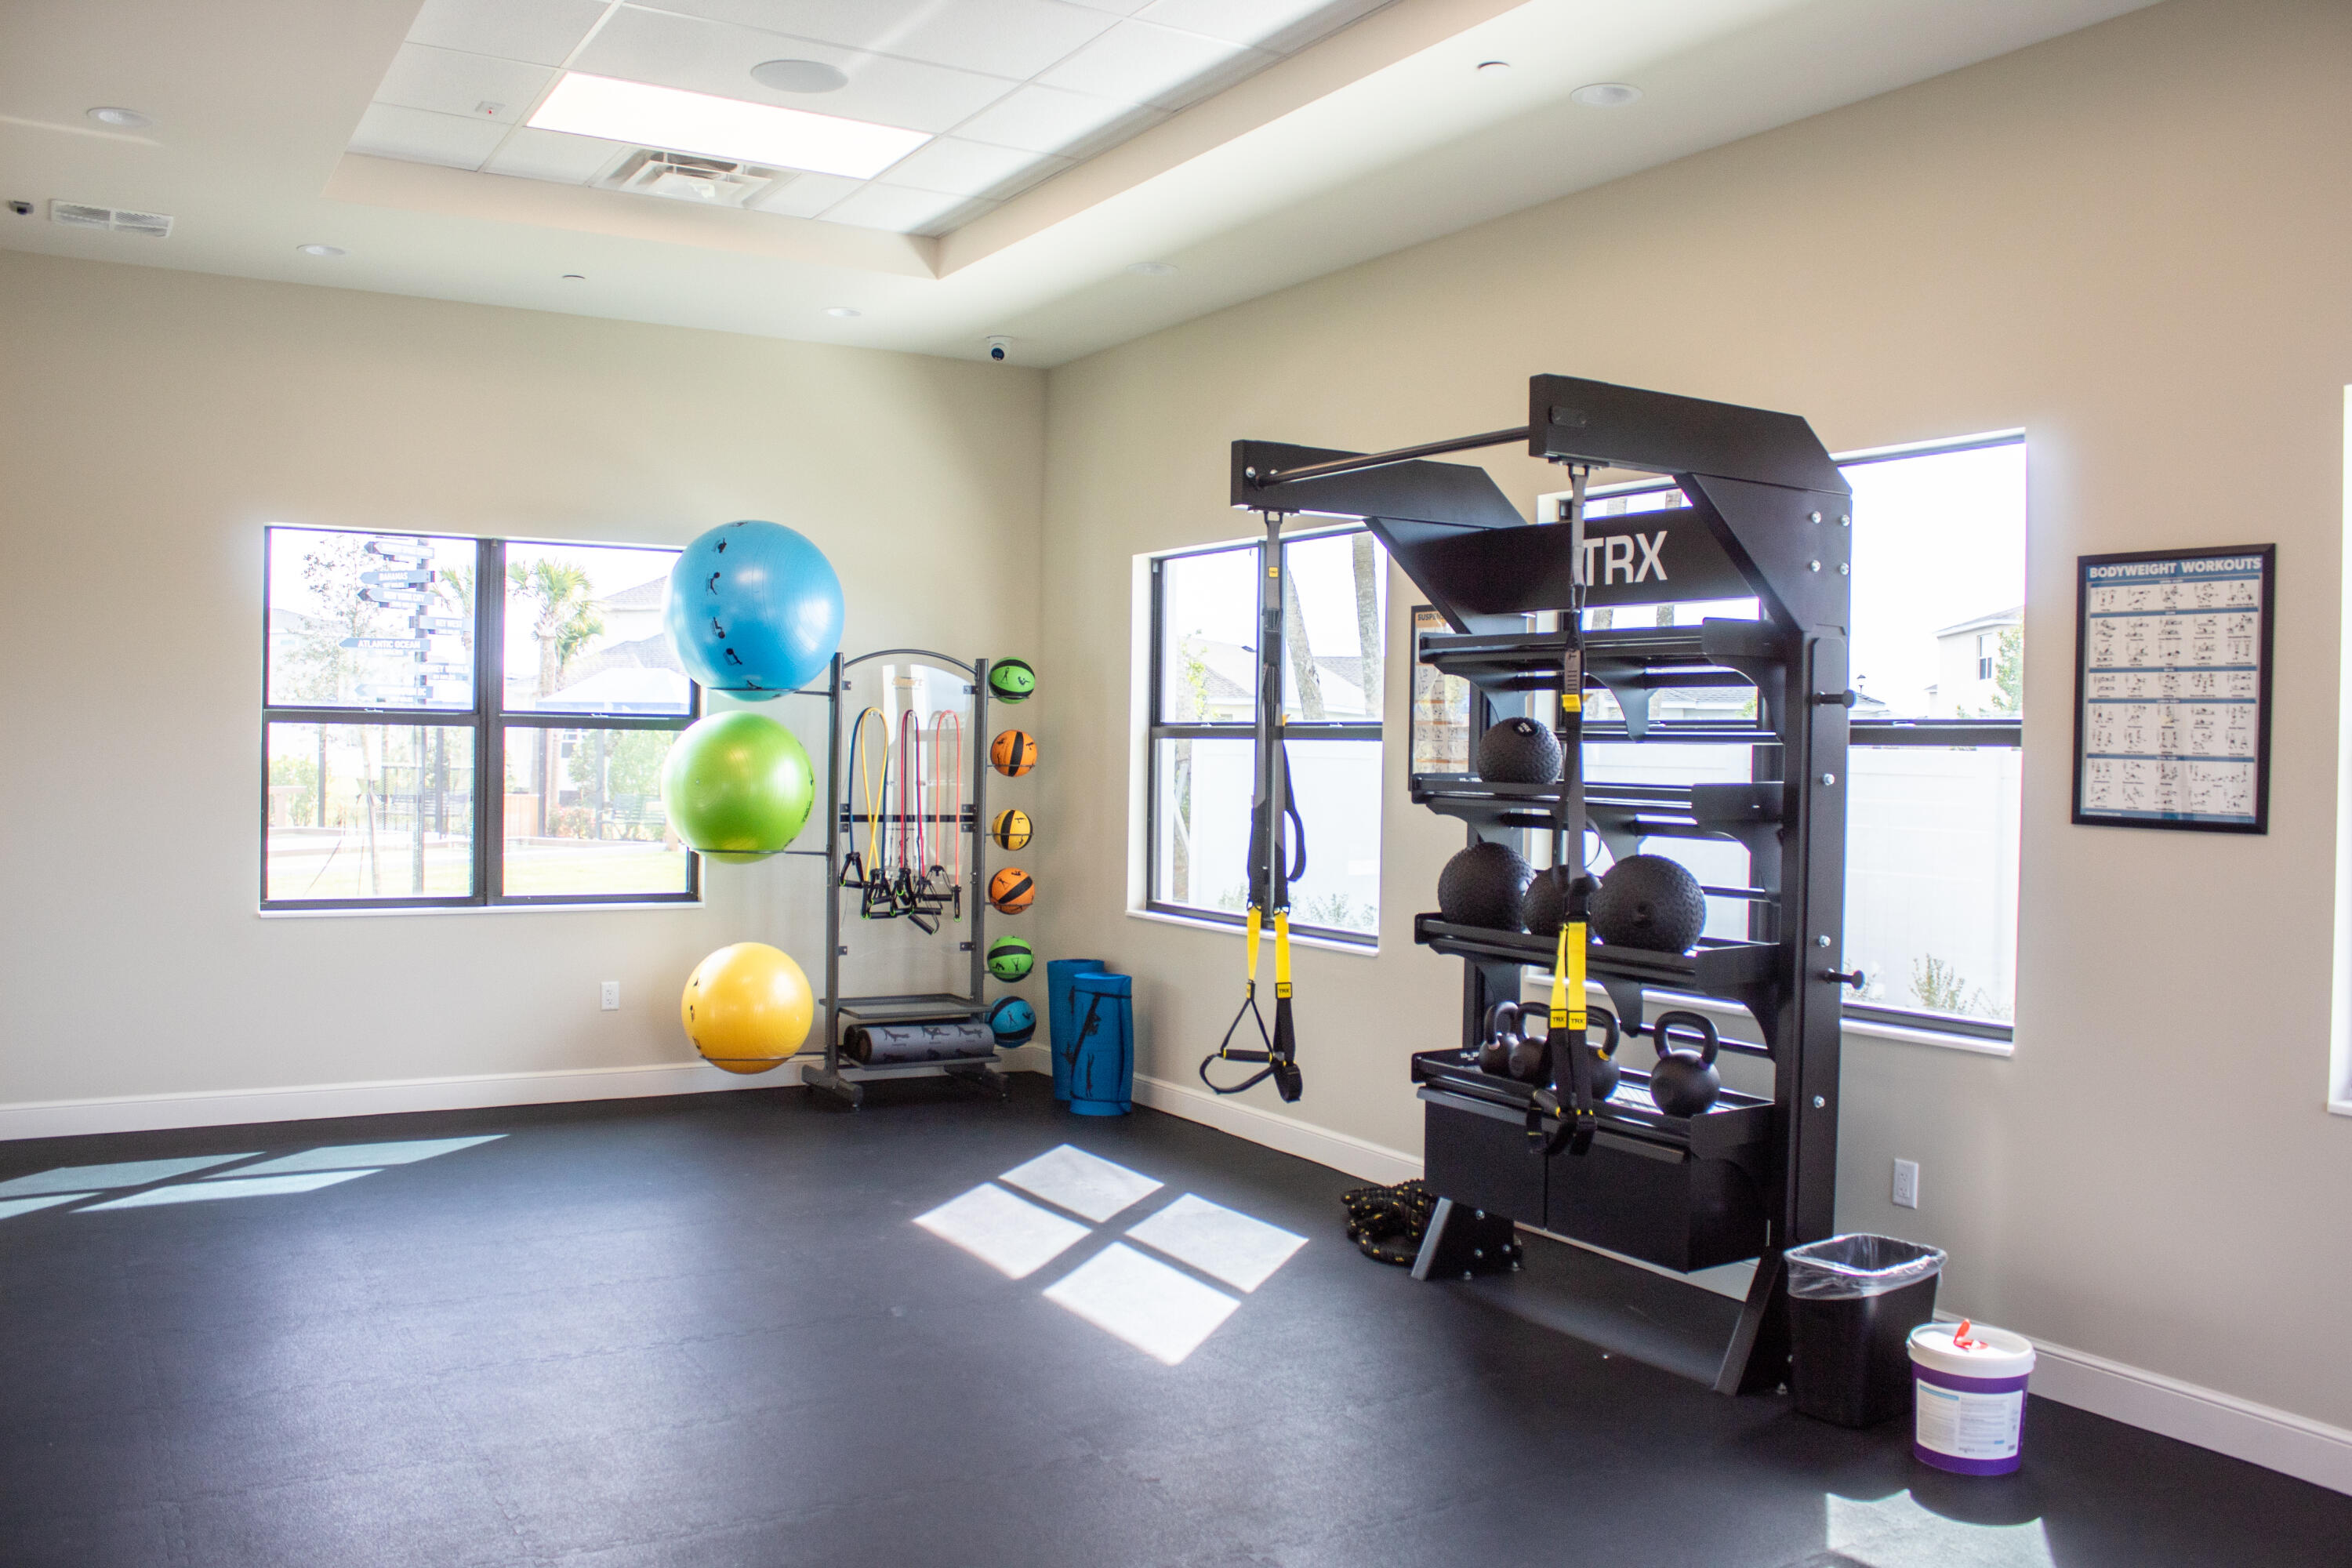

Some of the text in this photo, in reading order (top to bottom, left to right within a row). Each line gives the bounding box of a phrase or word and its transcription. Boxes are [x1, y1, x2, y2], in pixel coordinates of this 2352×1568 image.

[1582, 530, 1668, 587] TRX
[2089, 557, 2262, 579] BODYWEIGHT WORKOUTS
[358, 640, 420, 649] ATLANTIC OCEAN
